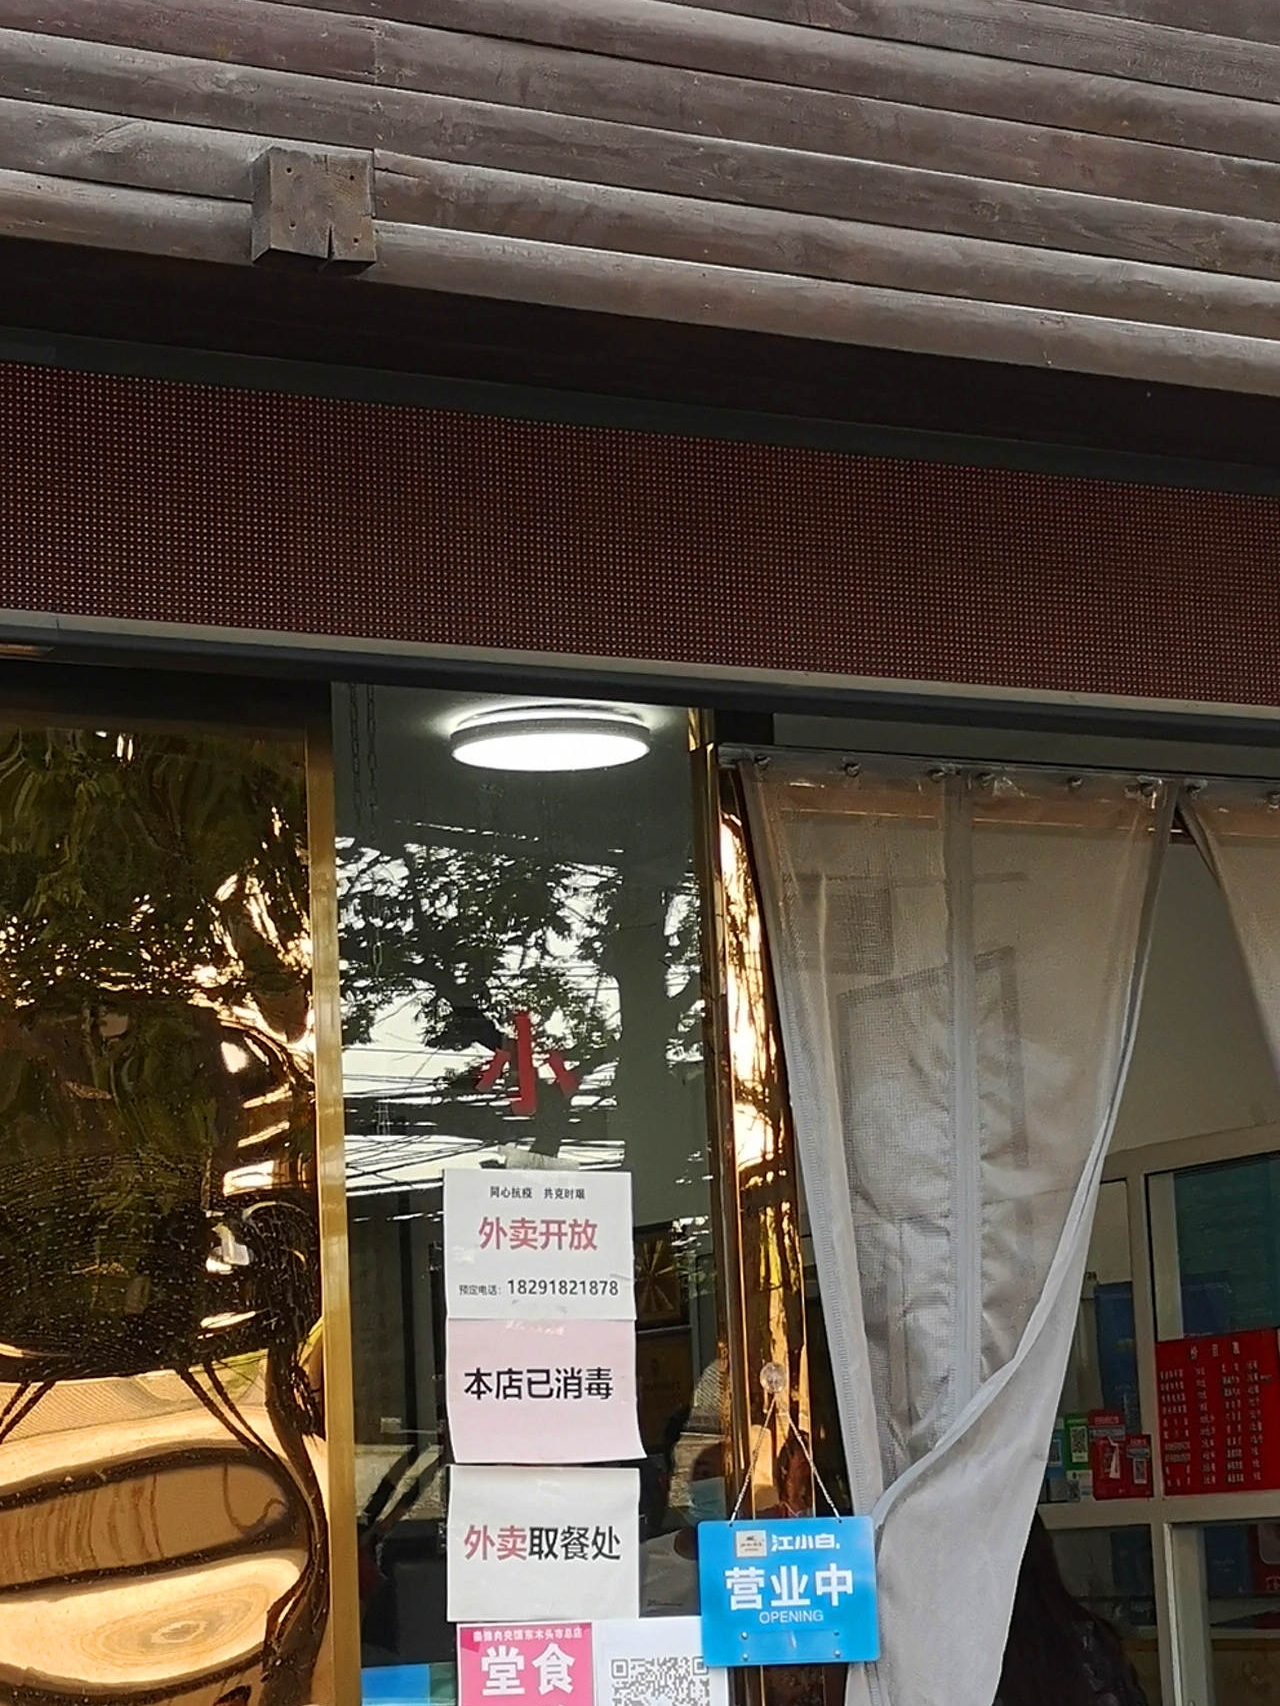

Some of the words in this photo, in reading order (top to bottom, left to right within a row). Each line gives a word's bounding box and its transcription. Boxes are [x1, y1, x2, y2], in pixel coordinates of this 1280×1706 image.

[489, 1186, 533, 1200] 同心抗疫
[544, 1187, 586, 1200] 共克时艰
[478, 1216, 598, 1251] 外卖开放
[508, 1279, 619, 1296] 18291821878
[463, 1367, 613, 1400] 本店已消毒
[464, 1524, 621, 1561] 外卖取餐处
[724, 1562, 854, 1611] 营业中
[759, 1609, 824, 1625] OPENING
[480, 1643, 576, 1696] 堂食
